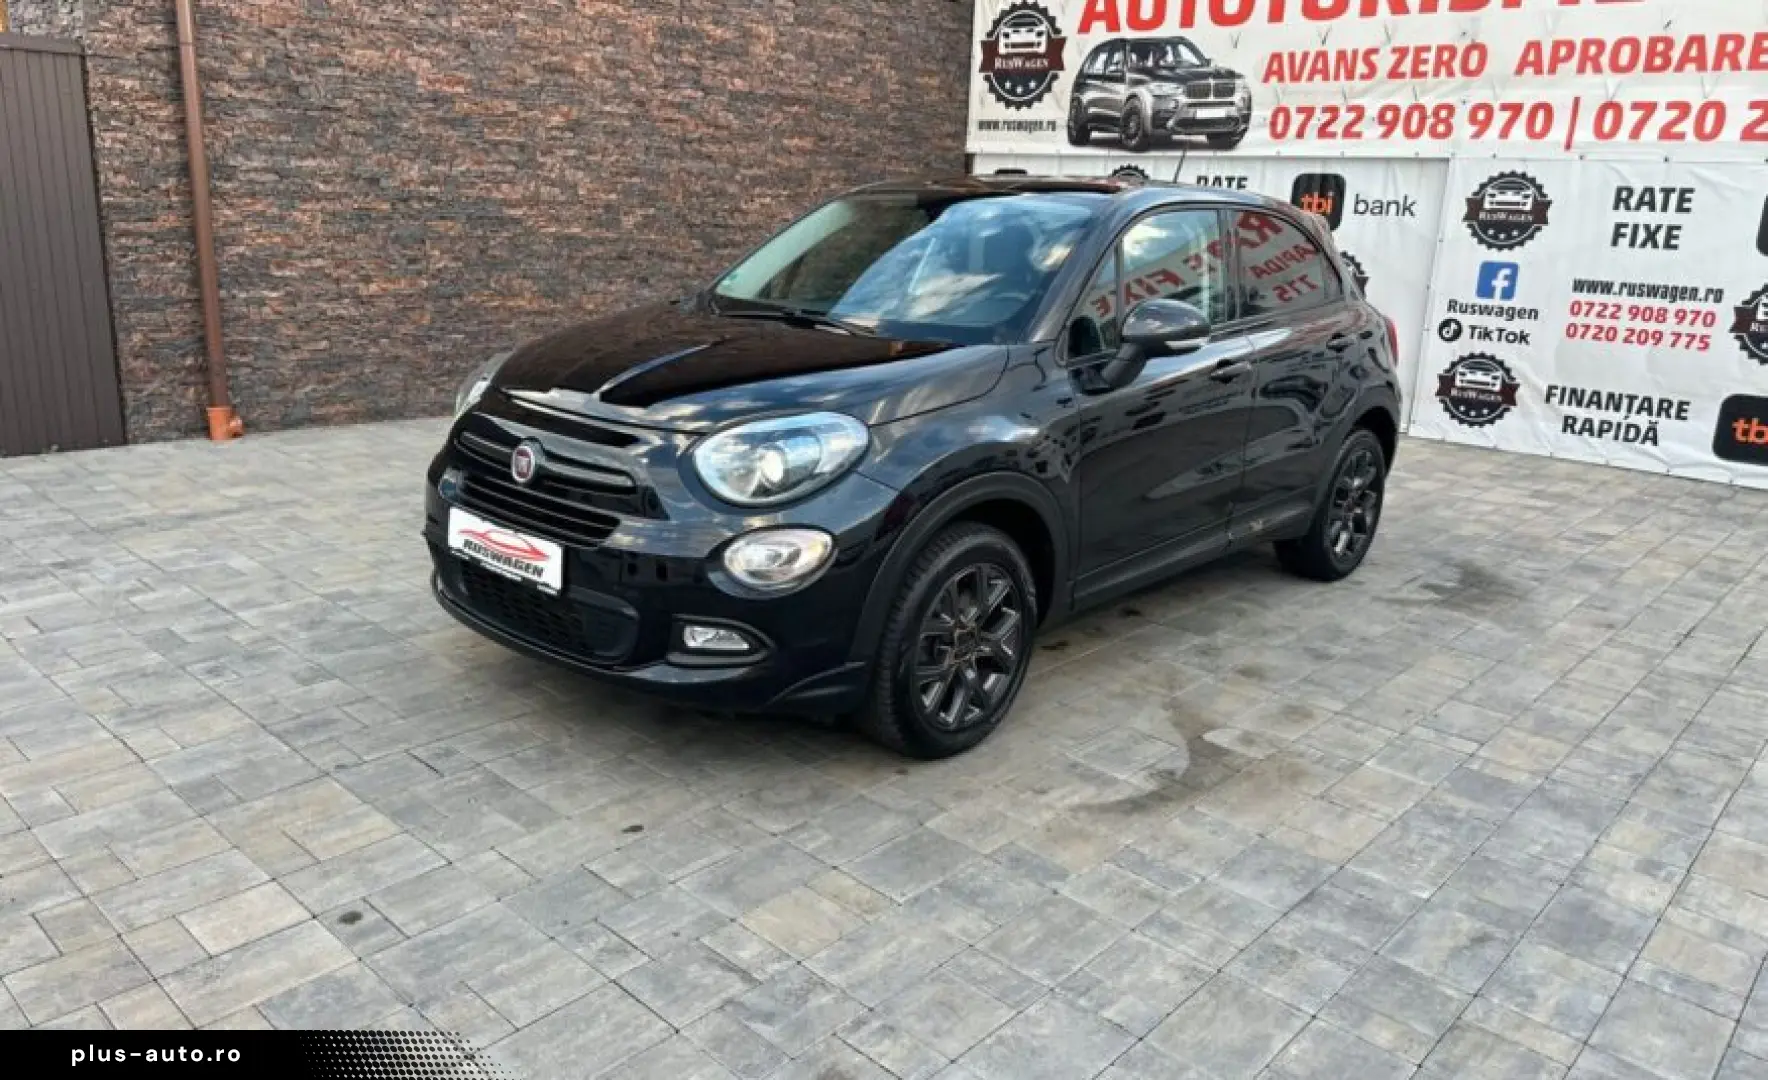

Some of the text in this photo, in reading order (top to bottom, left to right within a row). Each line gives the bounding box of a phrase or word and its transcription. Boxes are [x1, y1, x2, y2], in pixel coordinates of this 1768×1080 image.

[1262, 32, 1768, 84] AVANS ZERO APROBARE
[1269, 104, 1366, 140] 0722
[1377, 102, 1456, 140] 908
[1468, 101, 1554, 140] 970
[1592, 99, 1727, 141] 0720
[1353, 194, 1416, 217] bank
[1612, 185, 1695, 214] RATE
[1611, 221, 1683, 251] FIXE
[1571, 277, 1725, 303] www.ruswagen.ro
[1446, 299, 1539, 321] Ruswagen
[1569, 301, 1717, 328] 0722 908 970
[1468, 324, 1531, 346] TikTok
[1565, 322, 1712, 352] 0720 209 775
[1561, 414, 1660, 447] RAPIDĂ
